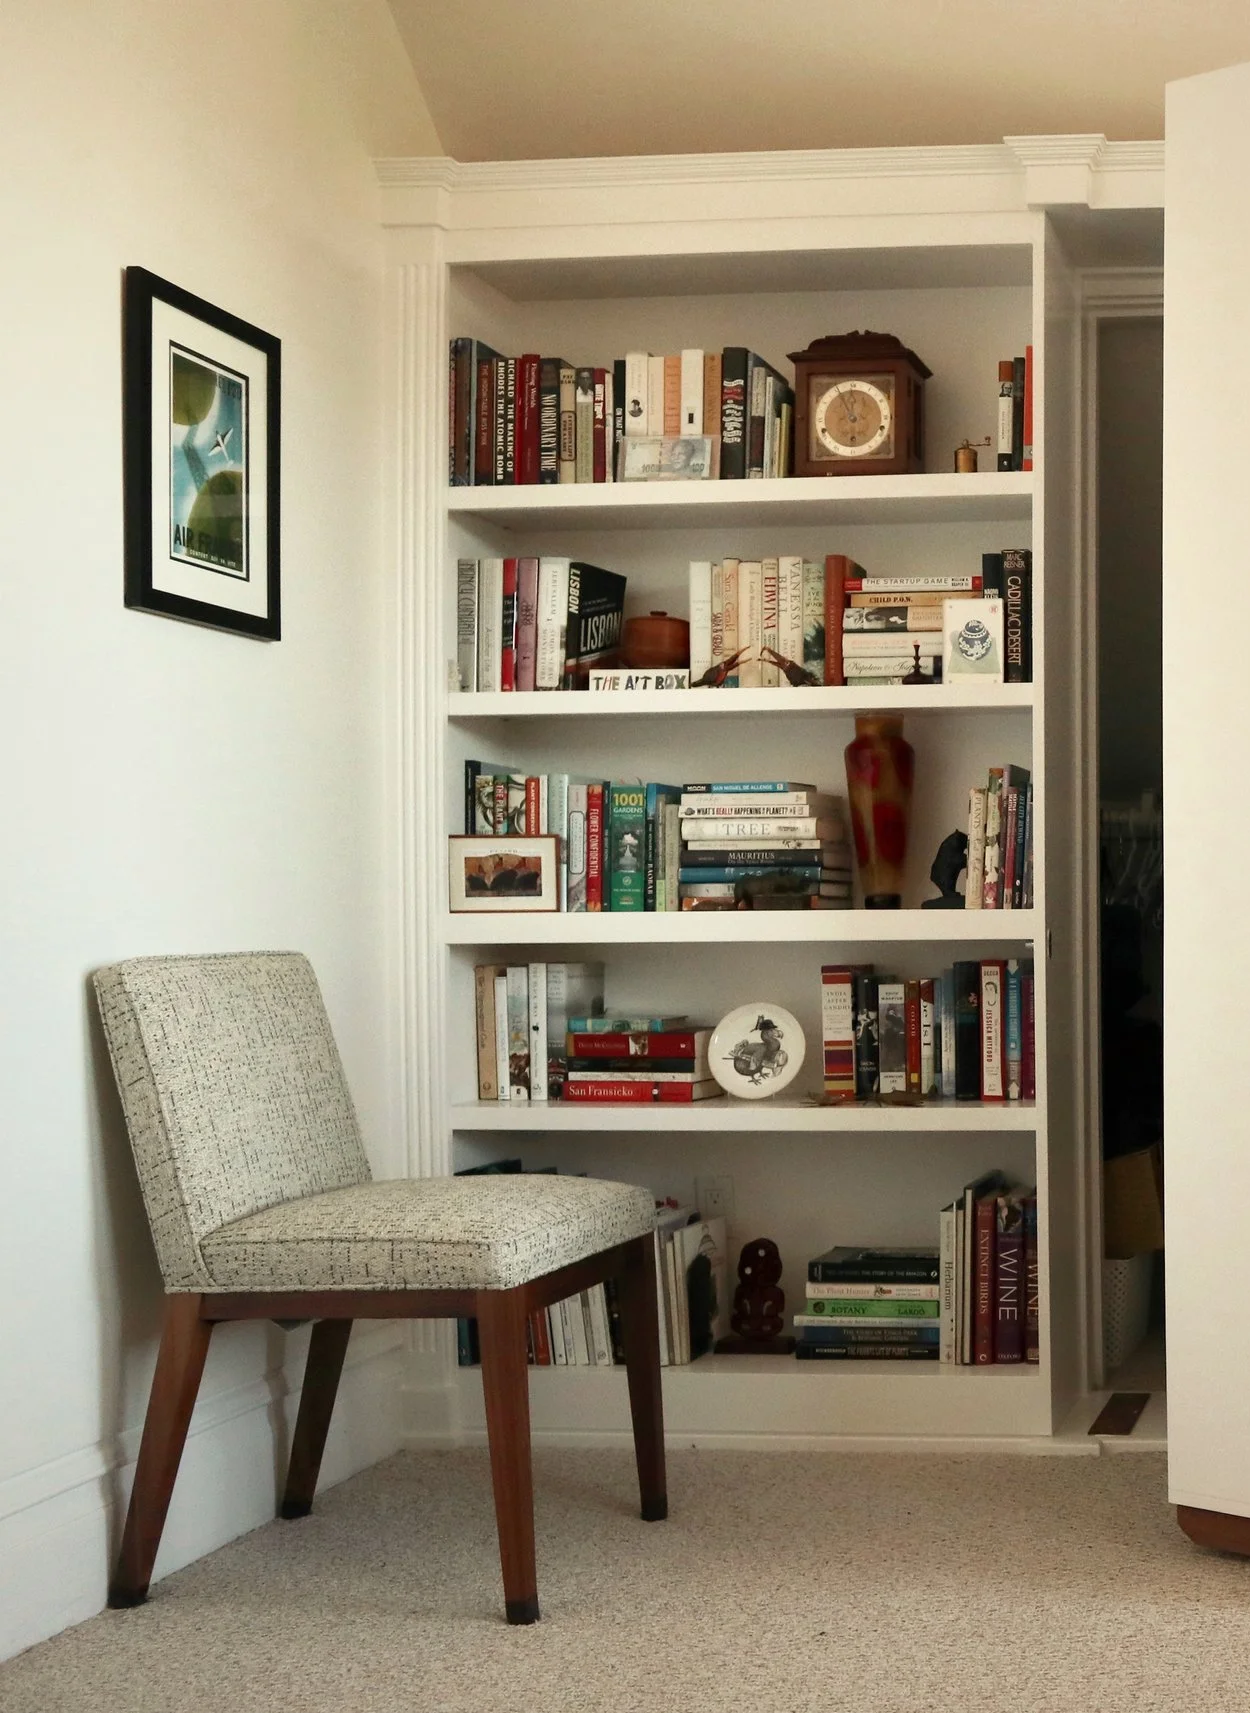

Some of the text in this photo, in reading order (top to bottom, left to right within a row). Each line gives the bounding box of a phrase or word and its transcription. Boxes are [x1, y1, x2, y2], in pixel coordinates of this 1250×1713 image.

[507, 359, 515, 397] RICHARD
[496, 362, 505, 480] RHODES THE ATOMIC BOMB
[506, 423, 514, 456] MAKING
[541, 394, 557, 471] NO ORDINARY TIME
[506, 461, 514, 472] OF
[174, 523, 194, 549] AIR
[568, 568, 581, 614] LISBON
[778, 576, 788, 618] BELL
[790, 560, 801, 632] VANESSA
[923, 577, 949, 585] GAME
[764, 576, 776, 630] EDWINA
[1006, 576, 1021, 665] CADILLAC DESERT
[580, 611, 621, 652] LISBON
[593, 676, 620, 691] THE
[655, 674, 687, 690] BOX
[613, 793, 645, 806] 1001
[696, 806, 788, 815] WHAT'S REALLY HAPPENING PLANET?
[589, 808, 600, 878] FLOWER CONFIDENTIAL
[721, 823, 771, 836] TREE
[727, 852, 775, 860] MAURITIUS
[985, 1009, 993, 1034] JESSICA
[569, 1085, 633, 1097] San Fransicko
[945, 1261, 954, 1311] Herbarium
[980, 1229, 989, 1315] EXTINCT BIRDS
[998, 1248, 1019, 1321] WINE
[1027, 1264, 1039, 1317] WINE
[831, 1306, 867, 1315] BOTANY
